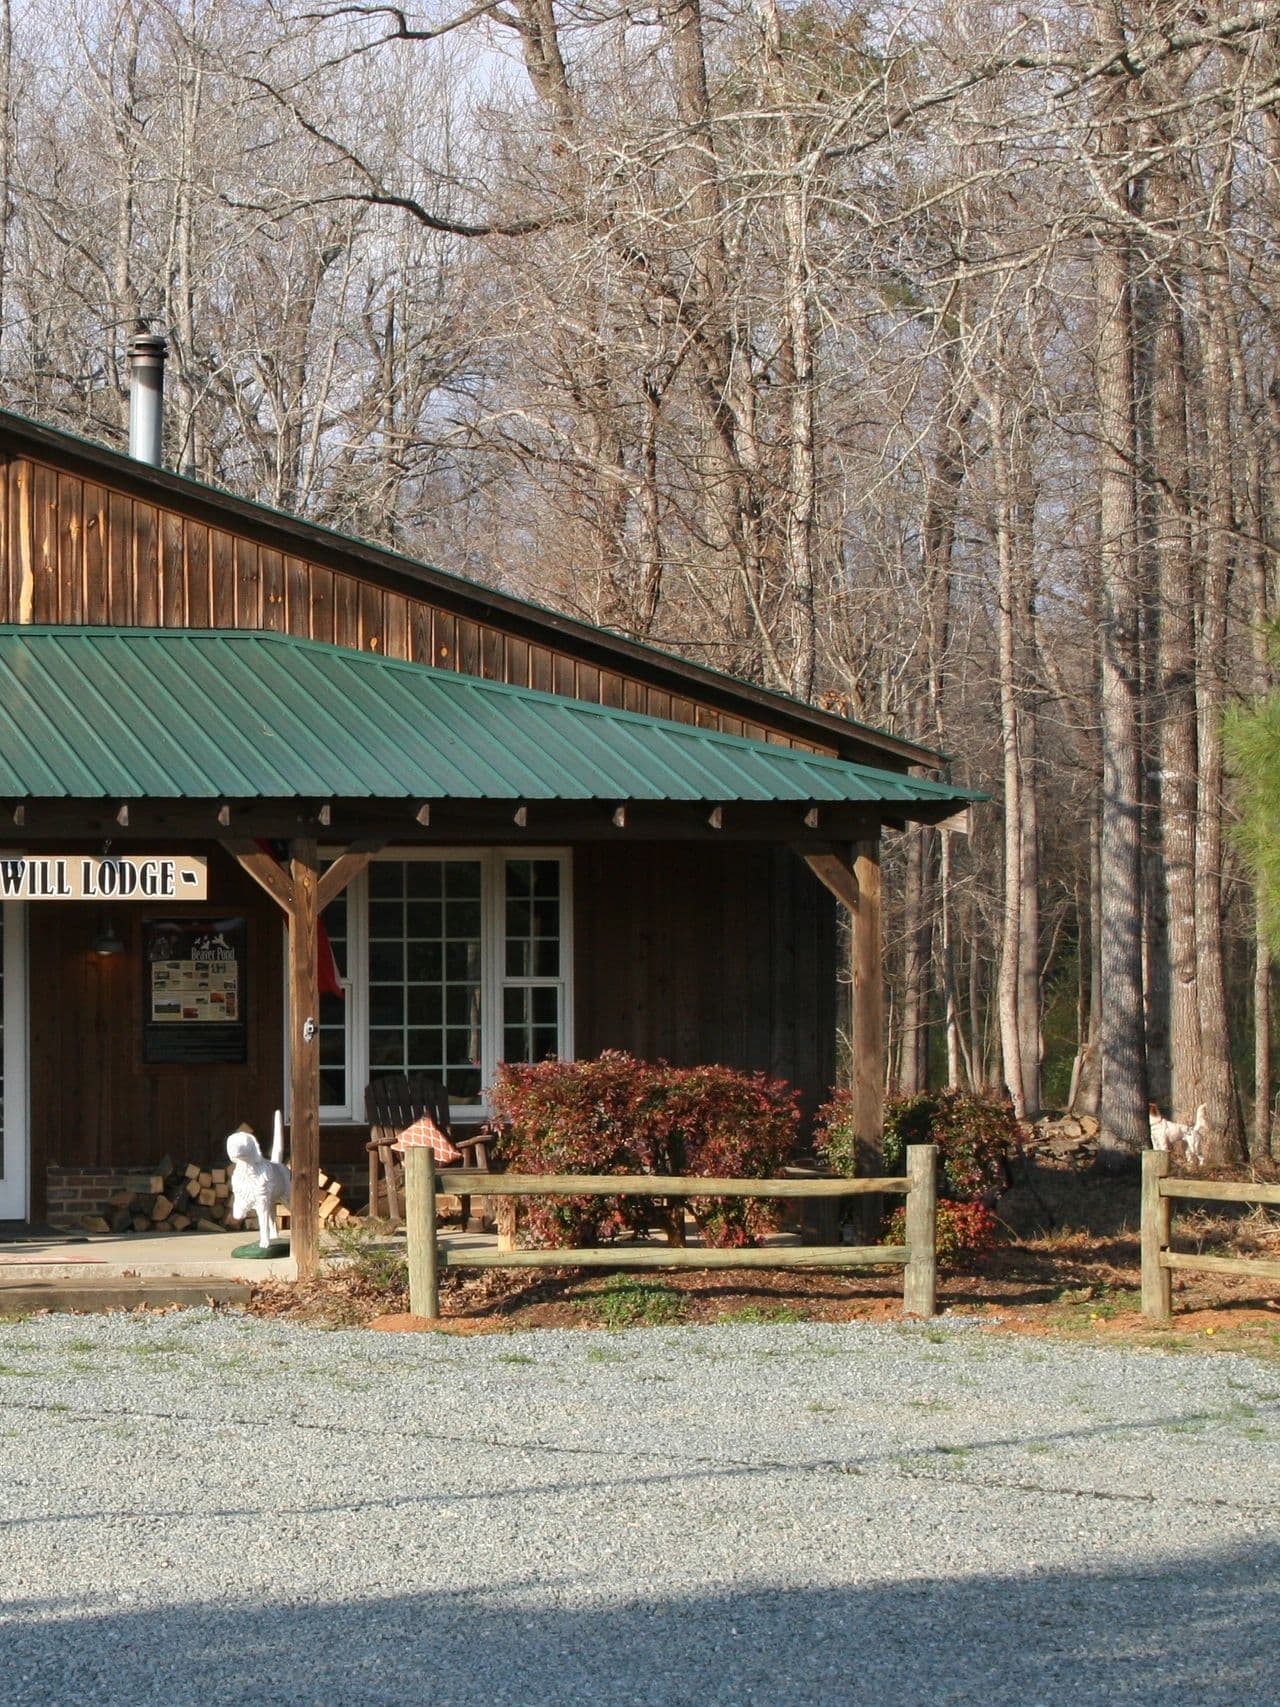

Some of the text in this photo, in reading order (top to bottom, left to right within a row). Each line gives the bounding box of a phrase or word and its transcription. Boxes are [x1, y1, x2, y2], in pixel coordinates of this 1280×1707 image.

[81, 860, 175, 896] LODGE
[191, 946, 235, 960] Beaver Pond
